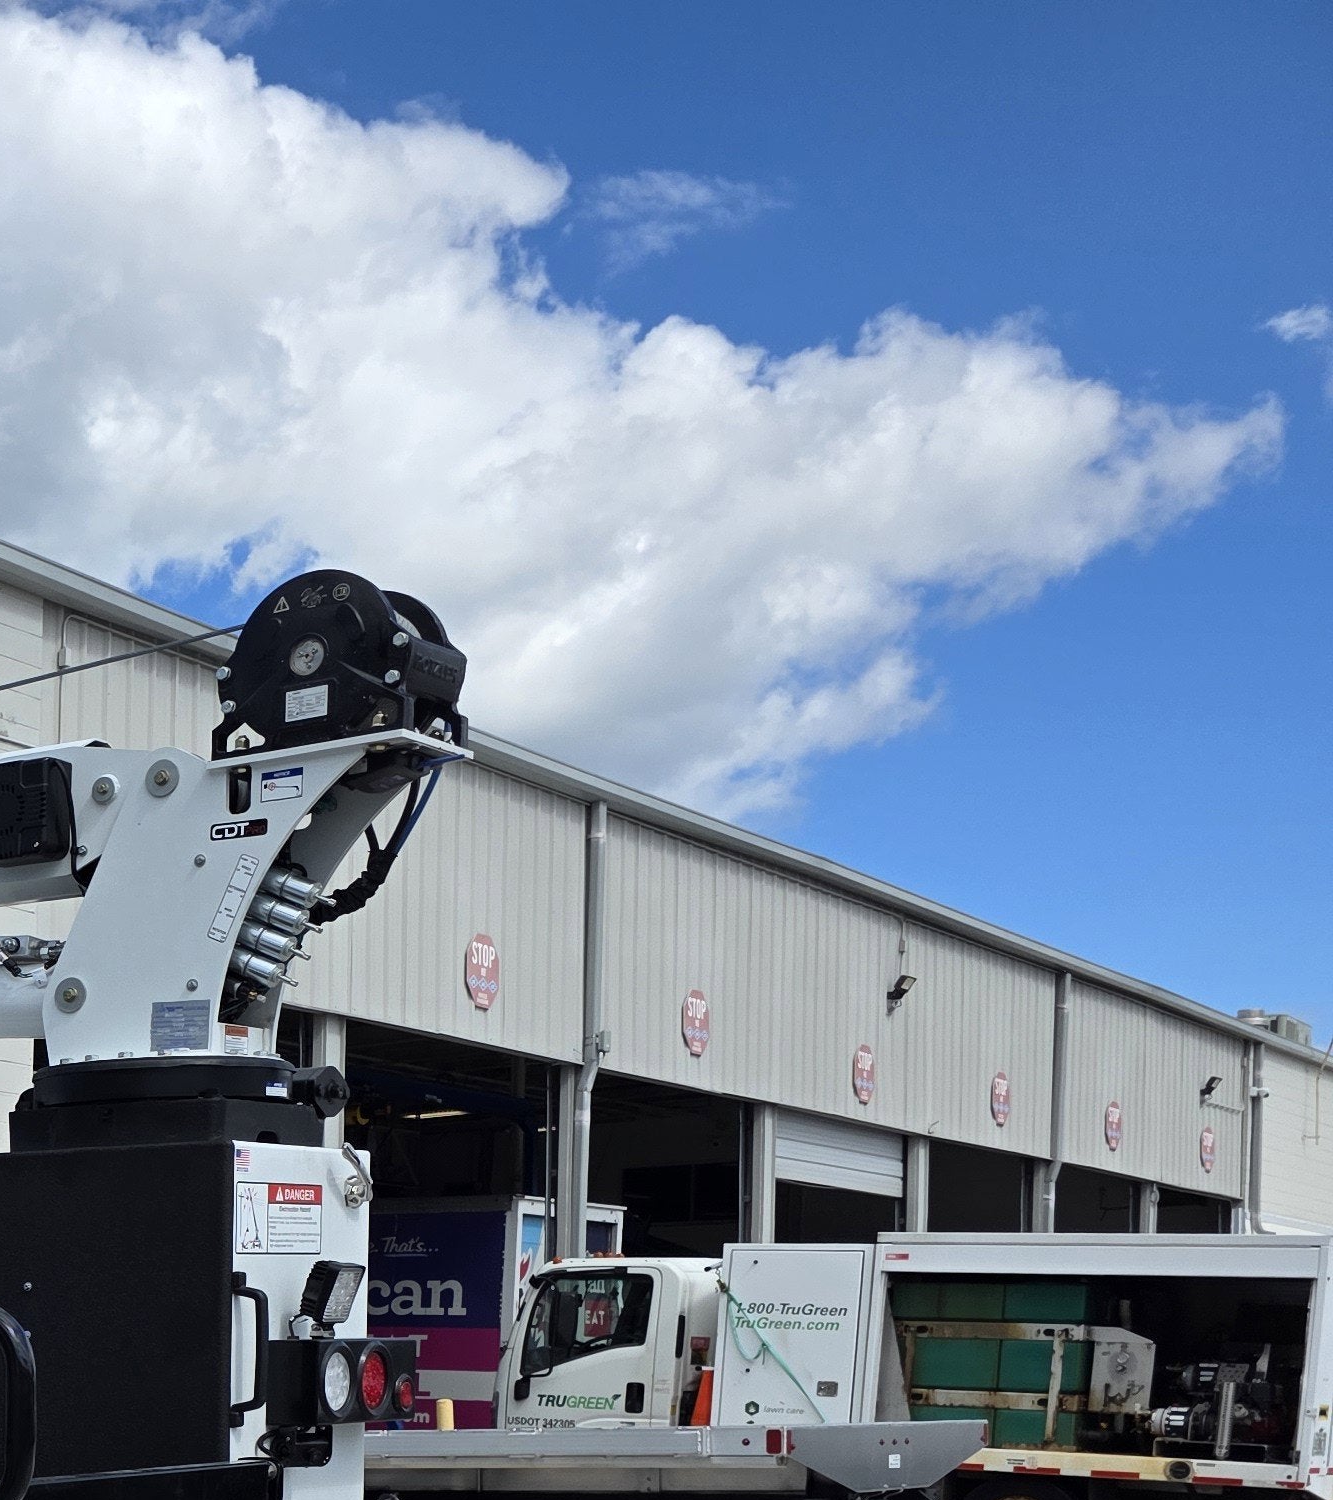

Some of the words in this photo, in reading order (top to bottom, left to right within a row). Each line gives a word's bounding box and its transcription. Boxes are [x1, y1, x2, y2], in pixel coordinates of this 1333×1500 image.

[472, 941, 496, 968] STOP
[687, 996, 707, 1020] STOP
[284, 1189, 315, 1201] DANGER
[734, 1316, 840, 1331] TruGreen.com
[537, 1393, 615, 1410] TRUGREEN
[507, 1416, 540, 1427] USDOT
